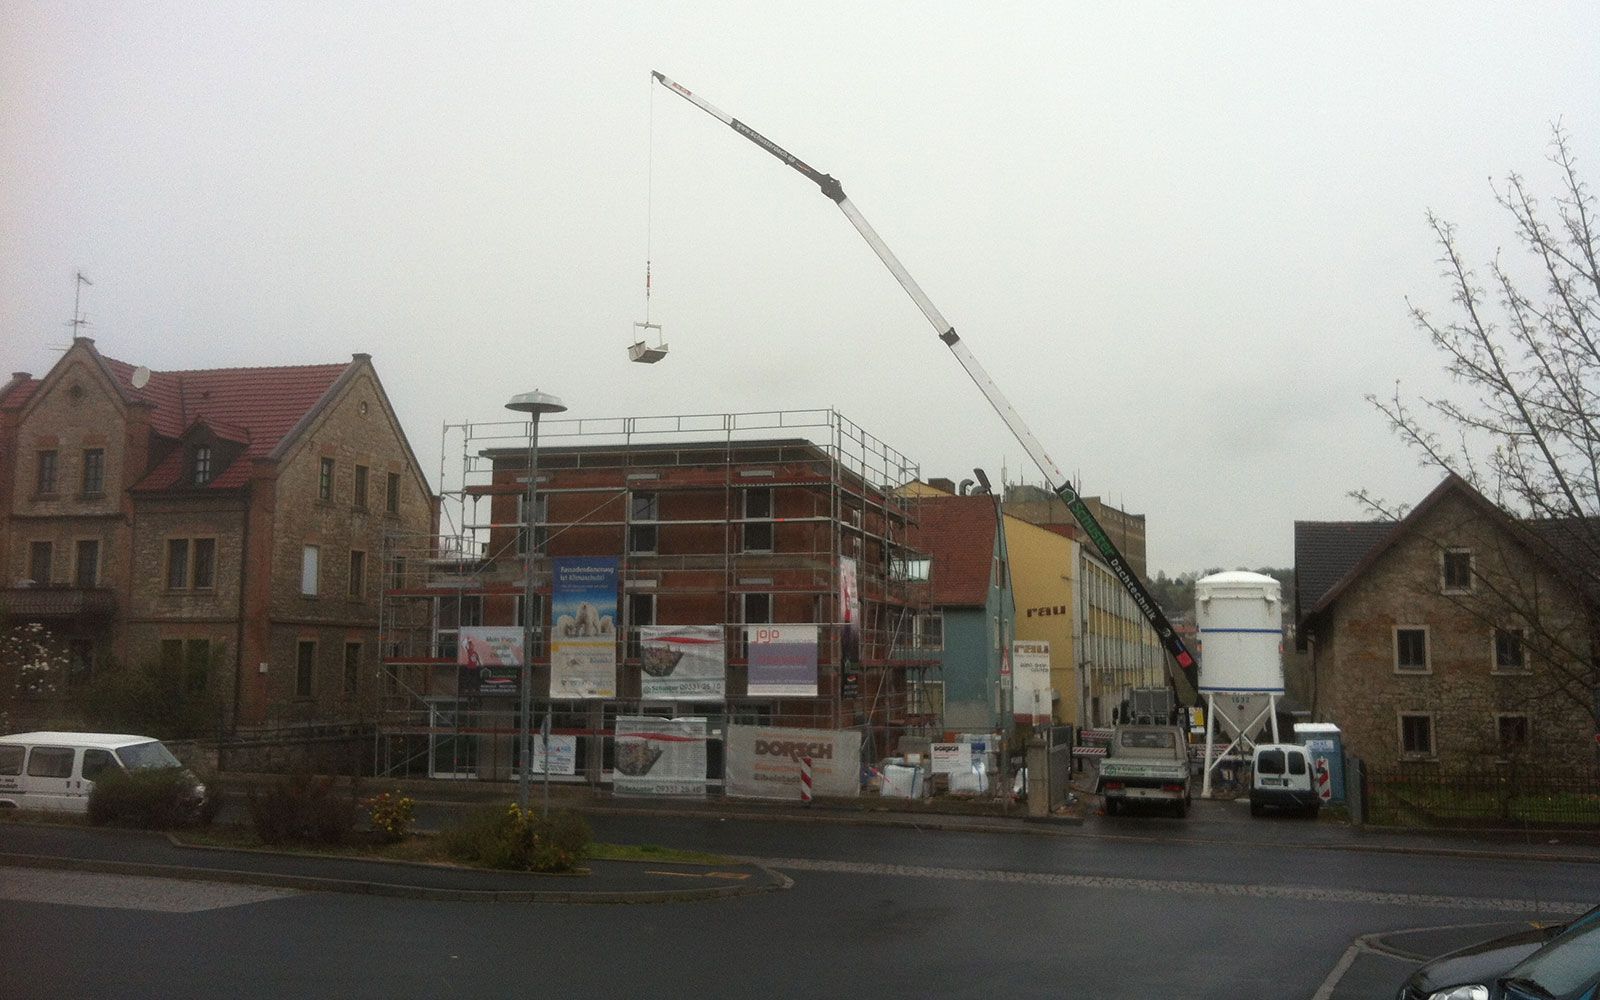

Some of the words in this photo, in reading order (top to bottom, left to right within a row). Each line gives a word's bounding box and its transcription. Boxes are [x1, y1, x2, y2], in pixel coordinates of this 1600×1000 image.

[1072, 502, 1115, 556] Schuster
[1110, 558, 1156, 620] Dachtechnik
[1027, 605, 1066, 618] rau
[754, 629, 780, 644] jojo
[1014, 645, 1049, 653] rau
[755, 740, 833, 763] DORSCH
